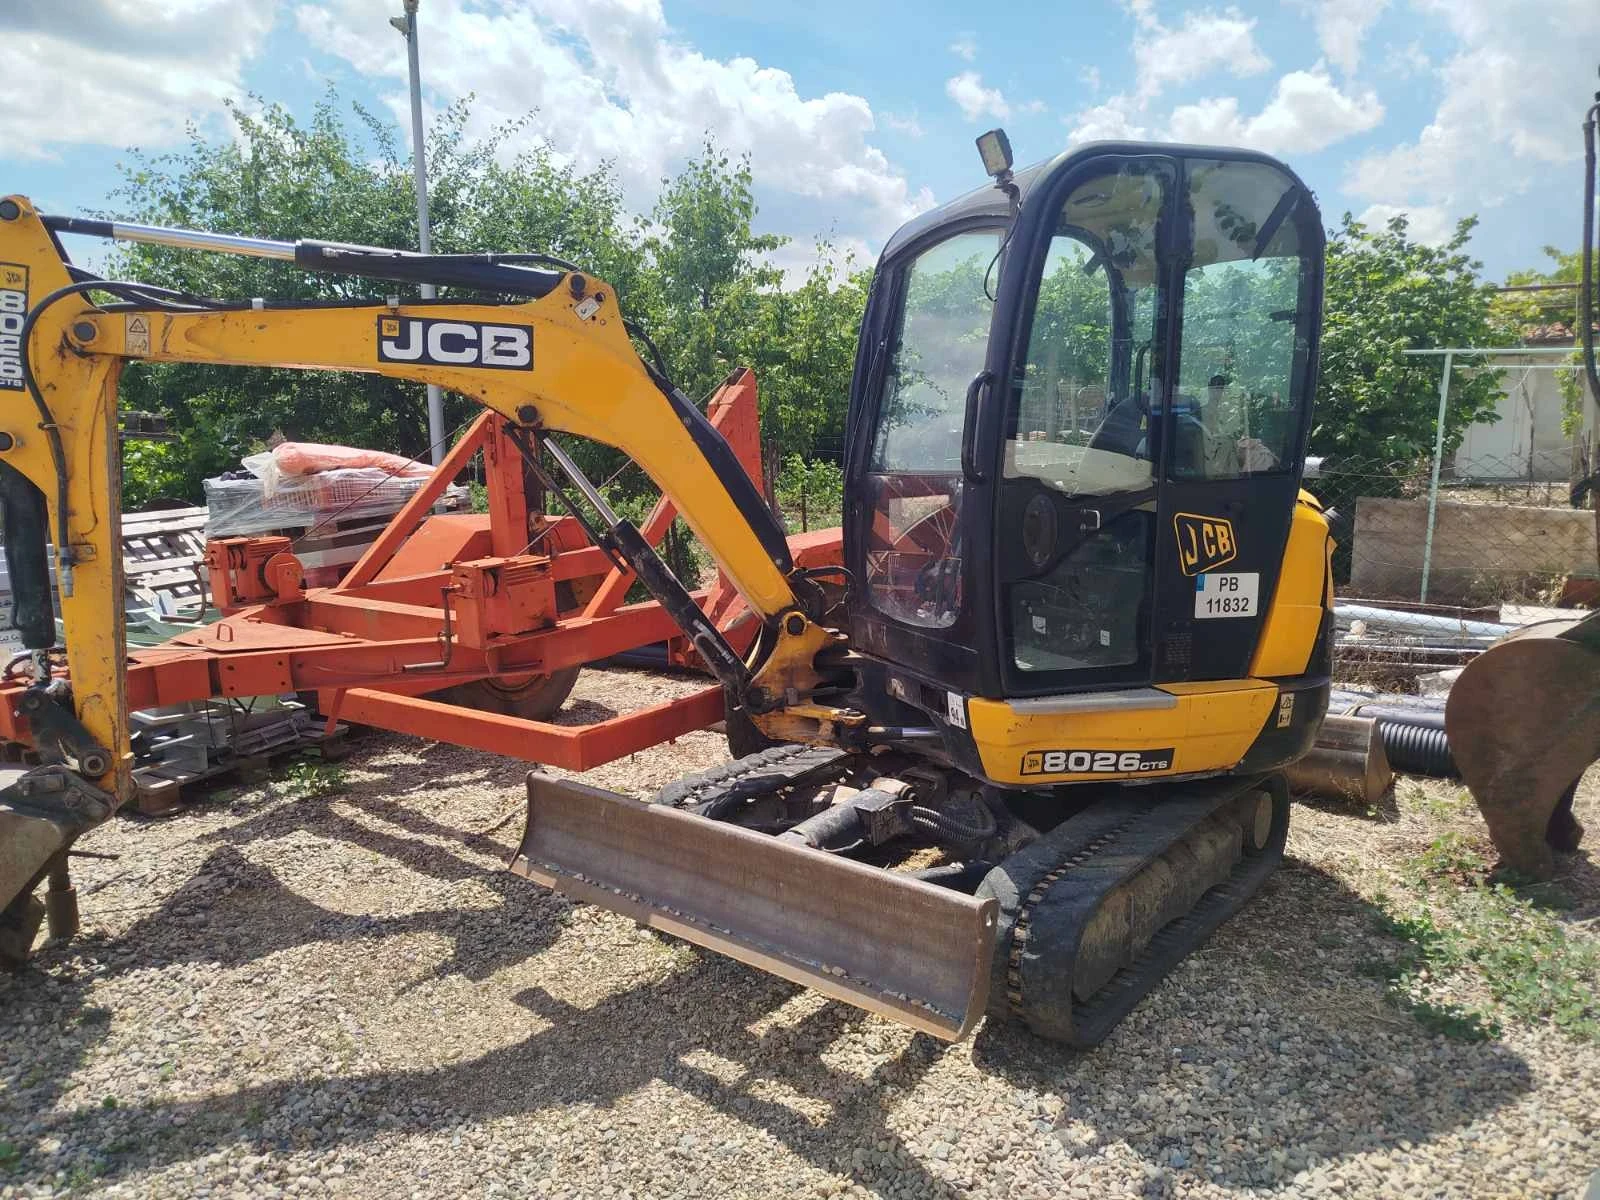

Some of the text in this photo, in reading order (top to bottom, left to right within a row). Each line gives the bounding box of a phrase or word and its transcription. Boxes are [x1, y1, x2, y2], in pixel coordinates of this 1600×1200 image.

[382, 321, 531, 367] JCB
[1185, 523, 1231, 566] JCB
[1219, 577, 1239, 592] PB
[1206, 597, 1249, 613] 11832
